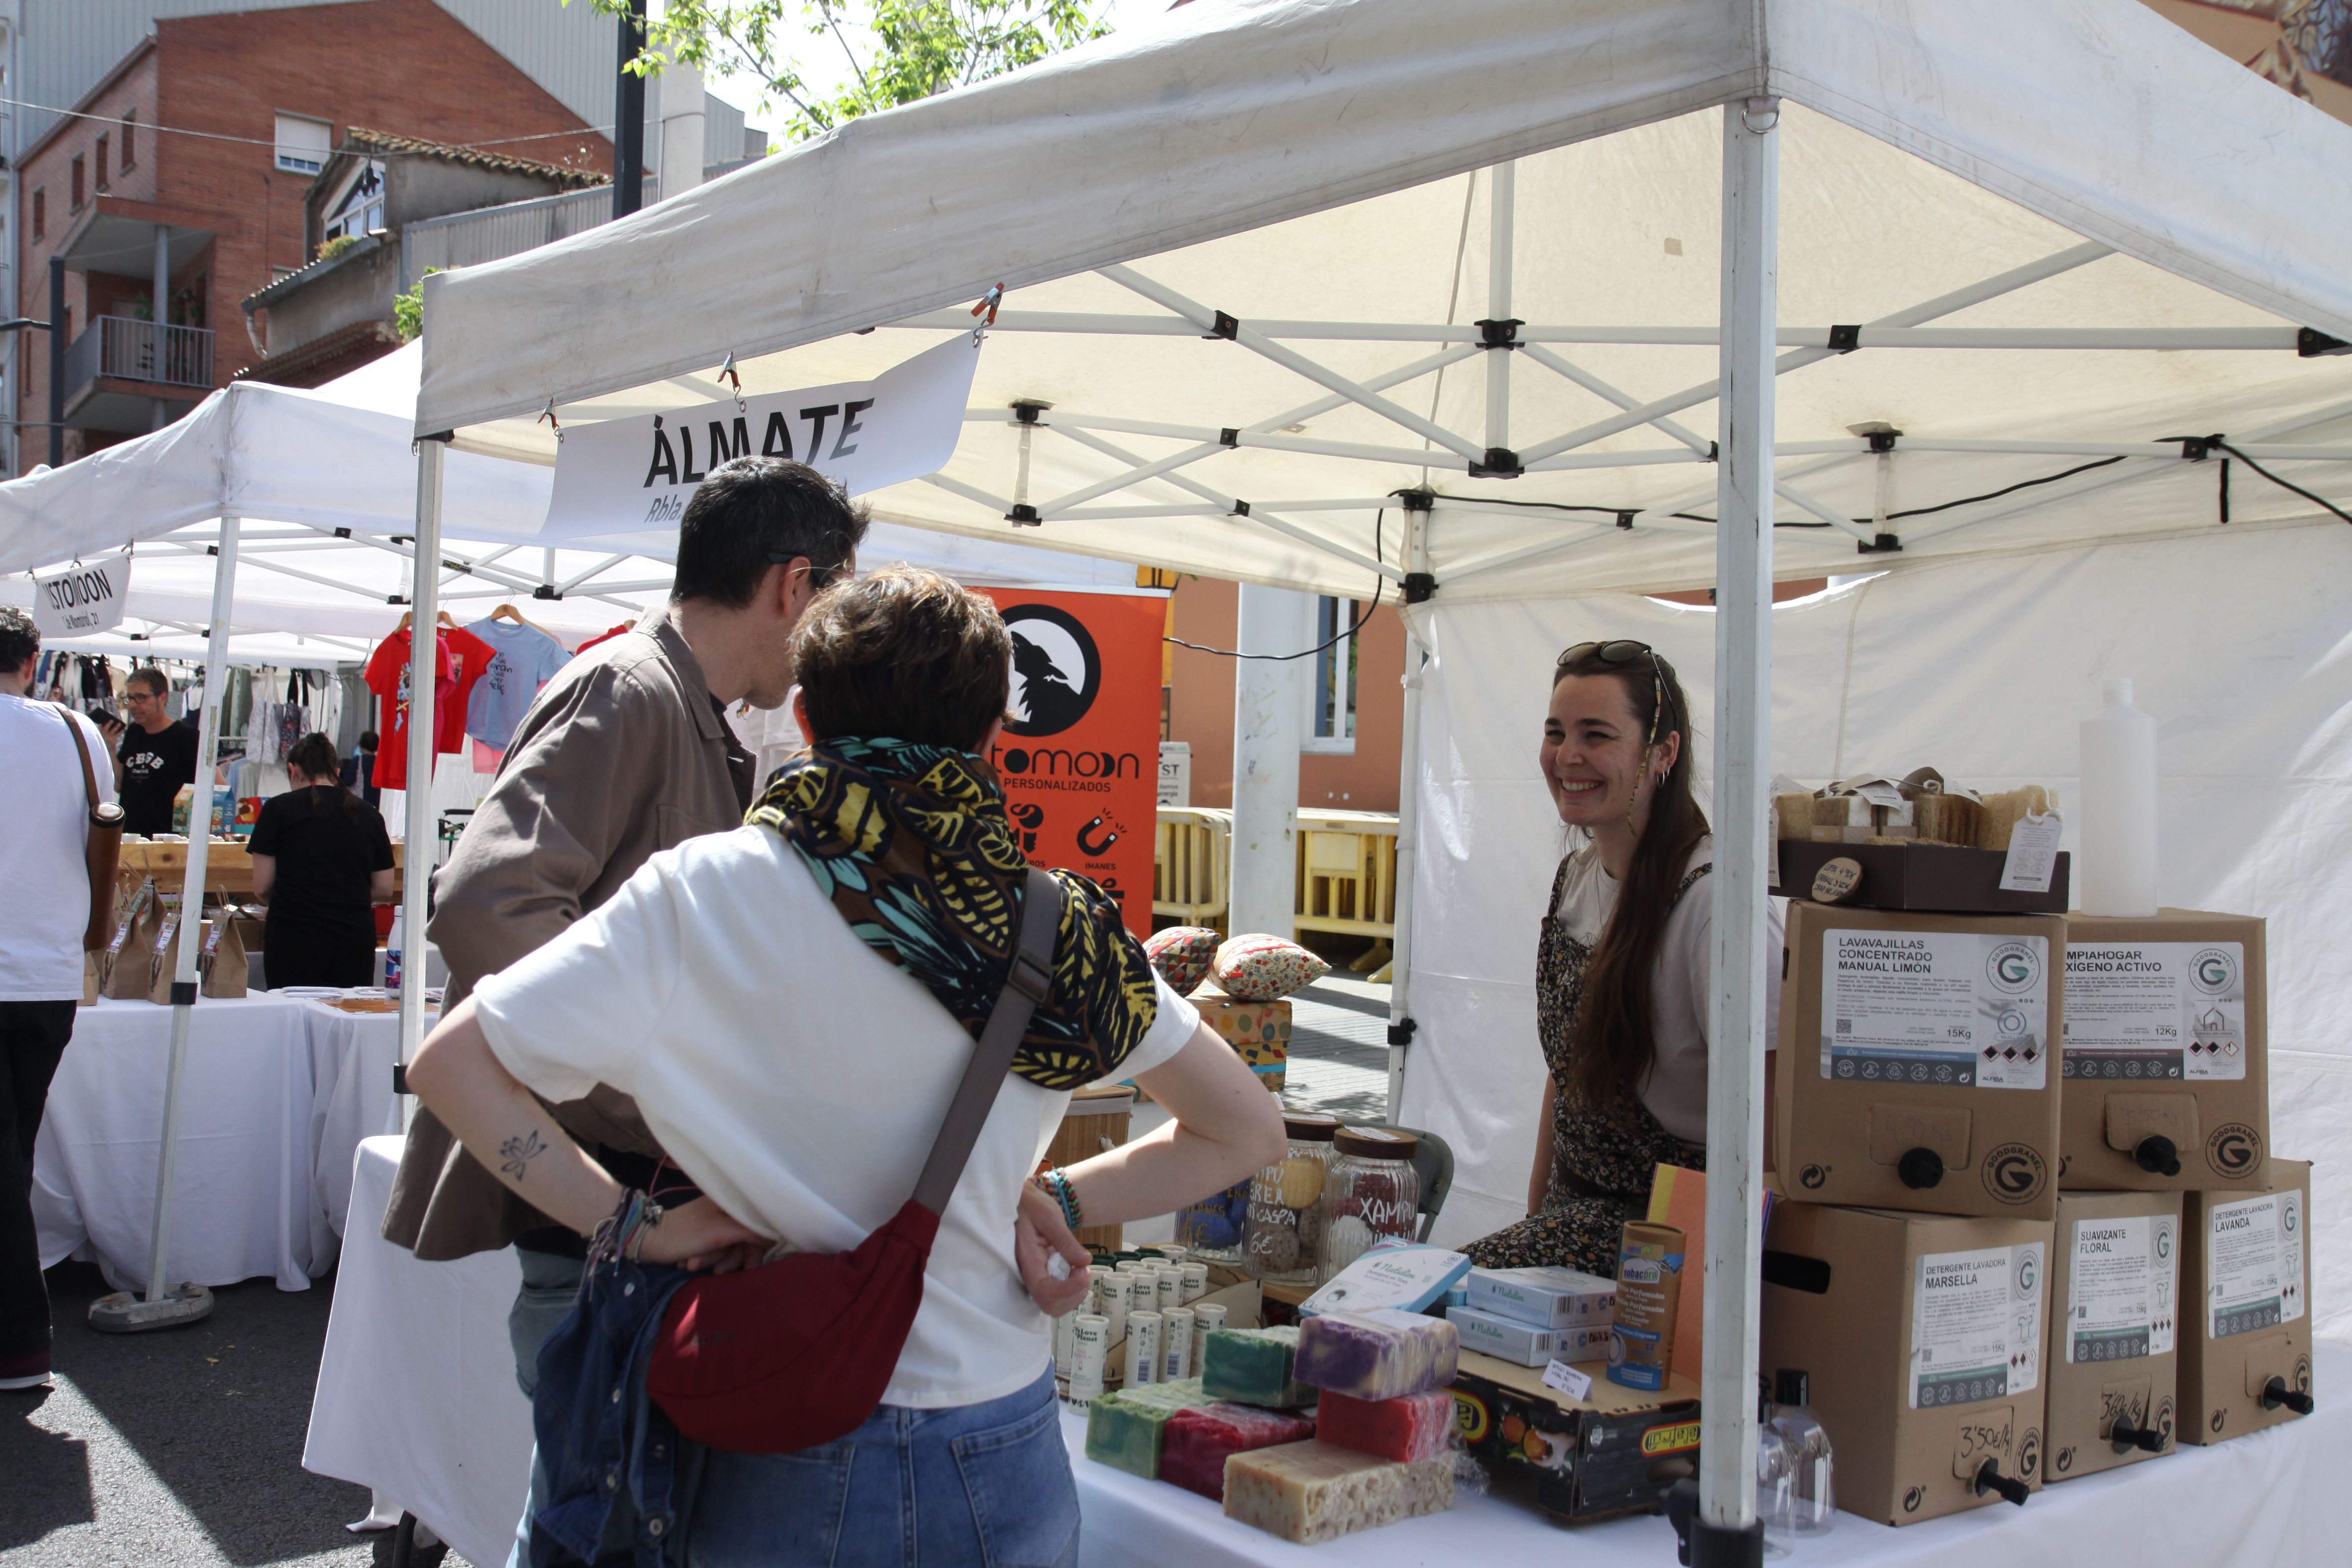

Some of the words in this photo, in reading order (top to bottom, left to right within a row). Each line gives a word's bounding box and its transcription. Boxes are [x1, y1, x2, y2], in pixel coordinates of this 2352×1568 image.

[91, 612, 99, 625] 21
[126, 751, 165, 769] CBGB
[1004, 778, 1111, 792] PERSONALIZADOS
[1085, 862, 1116, 870] IMANES
[1839, 937, 1924, 949] LAVAVAJILLAS
[1838, 949, 1932, 962] CONCENTRADO
[1992, 946, 2034, 965] GOODGRANEL
[2066, 951, 2142, 960] MPIAHOGAR
[2193, 952, 2231, 968] GOODGRANEL
[1838, 961, 1889, 972] MANUAL
[1893, 962, 1931, 974] LIMÓN
[2065, 960, 2113, 972] XÍGENO
[2115, 962, 2162, 972] ACTIVO
[1947, 1029, 1971, 1039] 15Kg
[2155, 1028, 2177, 1037] 12Kg
[2210, 1127, 2257, 1148] GOODGRANEL
[1987, 1146, 2042, 1172] GOODGRANEL
[1258, 1208, 1296, 1227] CASPA
[2215, 1207, 2248, 1220] DETERGENTE
[2249, 1202, 2273, 1215] LAVADORA
[2215, 1217, 2250, 1233] LAVANDA
[2080, 1229, 2126, 1241] SUAVIZANTE
[1250, 1231, 1273, 1254] 6€
[2080, 1242, 2112, 1253] FLORAL
[1926, 1262, 1971, 1275] DETERGENTE
[1972, 1258, 2006, 1270] LAVADORA
[1623, 1268, 1658, 1280] nobacpro
[1925, 1273, 1978, 1289] MARSELLA
[1498, 1286, 1525, 1302] Natulim
[1630, 1288, 1665, 1300] Perfumadas
[1629, 1301, 1665, 1313] Perfumadas
[1476, 1322, 1504, 1339] Natulim
[1992, 1344, 2005, 1353] 15Kg
